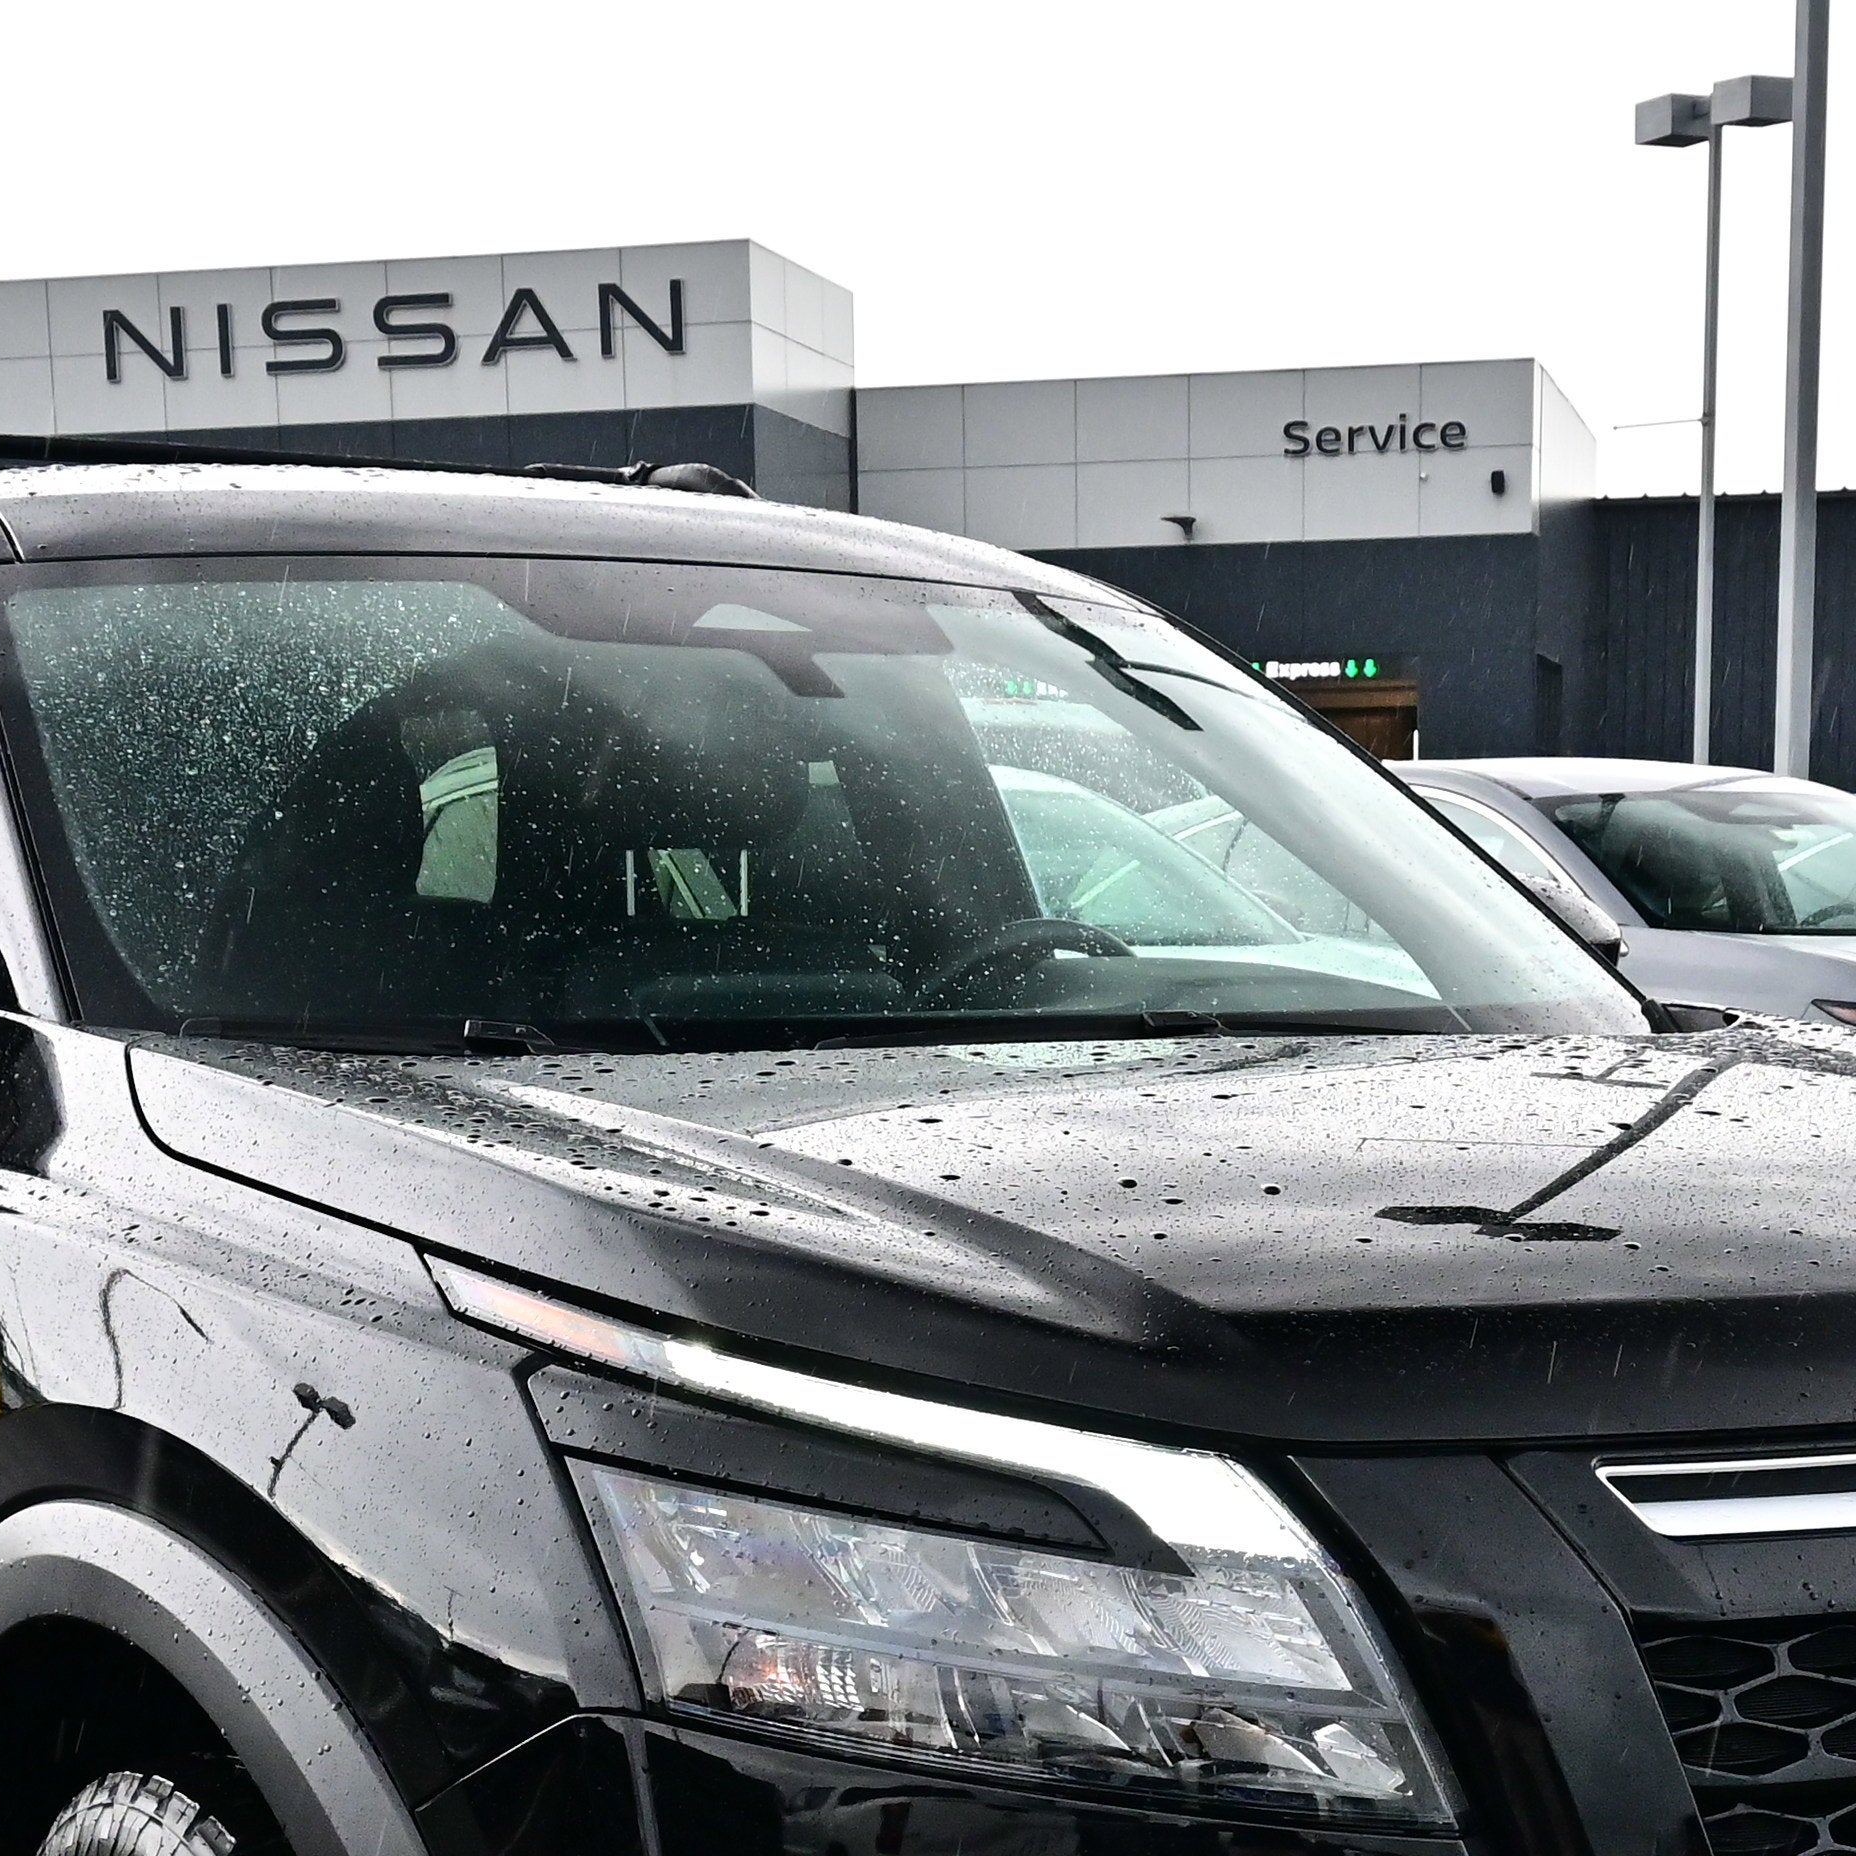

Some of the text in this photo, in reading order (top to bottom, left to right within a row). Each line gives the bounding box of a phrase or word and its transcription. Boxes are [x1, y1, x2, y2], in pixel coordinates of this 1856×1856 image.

[103, 279, 685, 382] NISSAN
[1283, 413, 1468, 456] Service
[1265, 661, 1341, 680] Express
